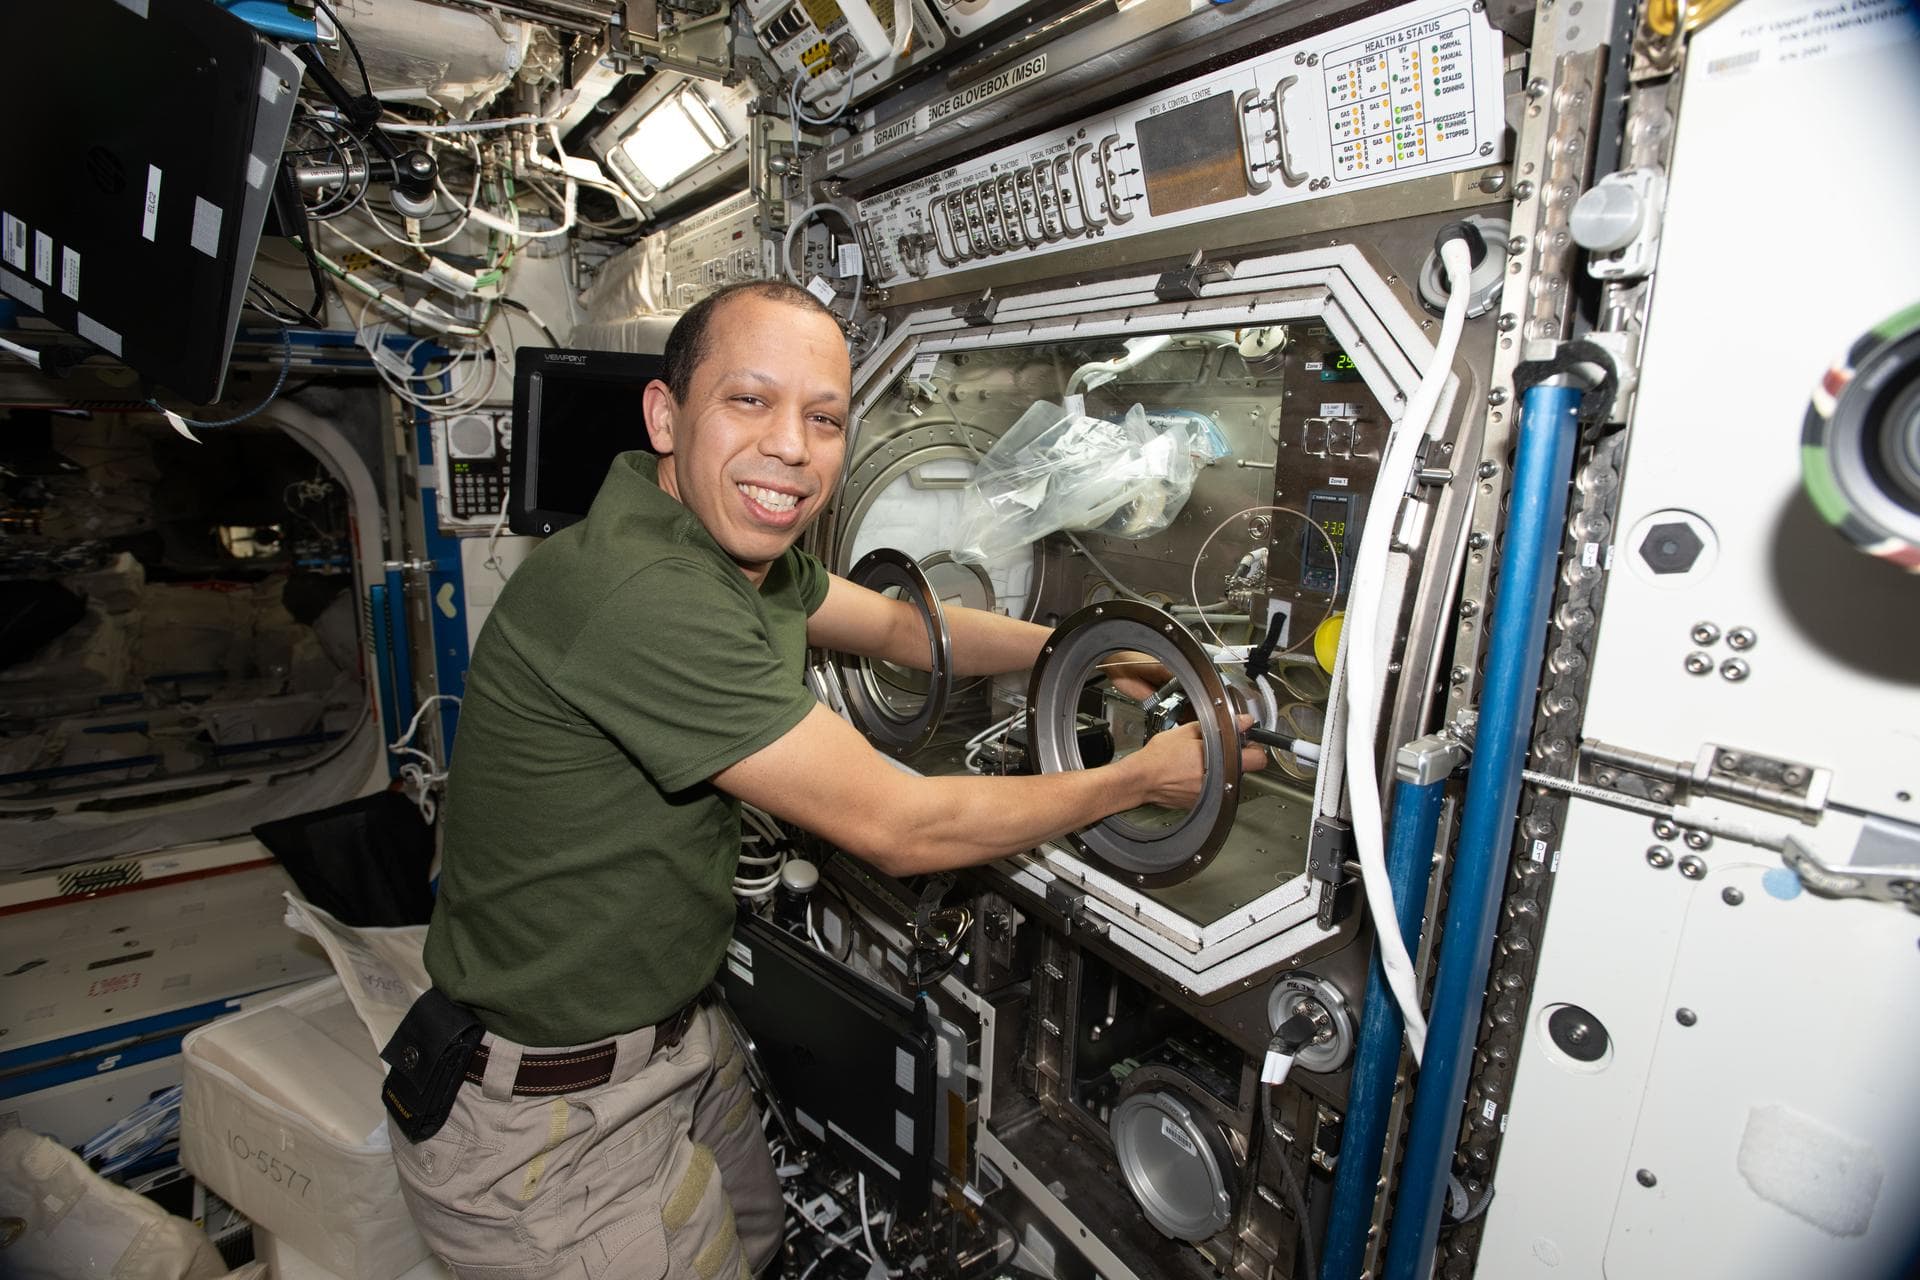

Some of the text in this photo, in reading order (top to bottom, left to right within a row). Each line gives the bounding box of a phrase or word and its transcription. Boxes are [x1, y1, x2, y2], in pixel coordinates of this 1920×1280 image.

[1365, 21, 1441, 53] HEALTH & STATUS
[1440, 39, 1462, 50] NORMAL
[1440, 50, 1463, 62] MANUAL
[1441, 72, 1463, 84] SEALED
[853, 119, 911, 156] MIGRAVITY
[953, 73, 1009, 110] GLOVEBOX
[1011, 56, 1046, 86] (MSG)
[1168, 95, 1190, 109] CONTROL
[1191, 87, 1212, 101] CENTRE
[1445, 129, 1469, 140] STOPPED
[147, 191, 156, 214] ELC2
